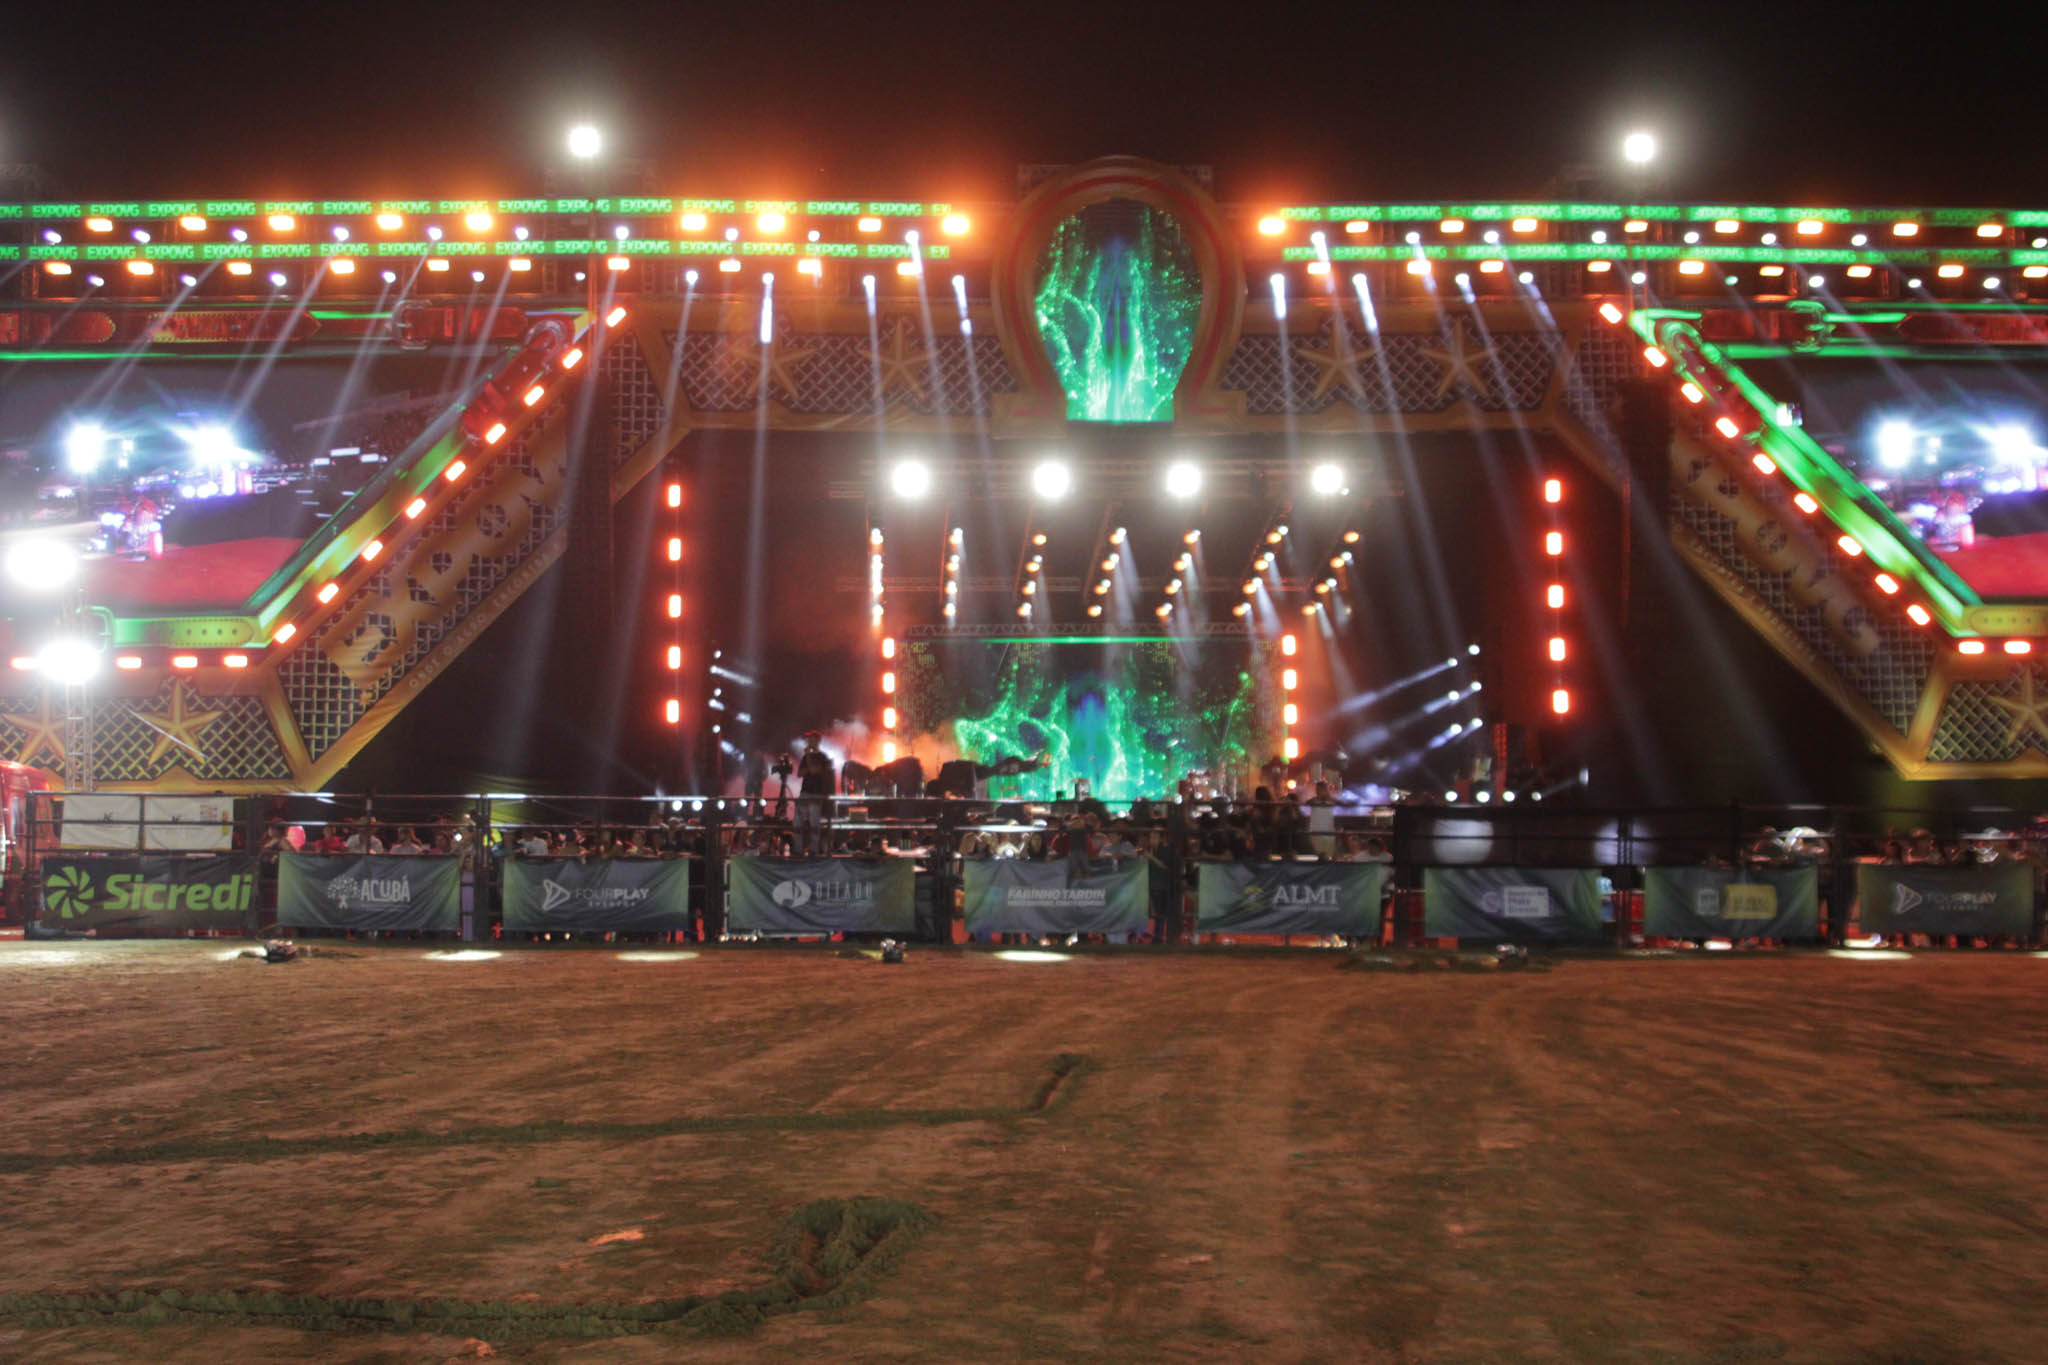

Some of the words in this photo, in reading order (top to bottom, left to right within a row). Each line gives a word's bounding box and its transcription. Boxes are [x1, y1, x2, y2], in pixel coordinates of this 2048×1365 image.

[32, 205, 81, 218] EXPOVG
[90, 203, 139, 216] EXPOVG
[149, 203, 198, 216] EXPOVG
[207, 202, 256, 216] EXPOVG
[265, 201, 314, 214] EXPOVG
[322, 201, 371, 214] EXPOVG
[381, 200, 431, 213] EXPOVG
[440, 200, 489, 213] EXPOVG
[498, 200, 547, 213] EXPOVG
[620, 199, 672, 213] EXPOVG
[683, 200, 735, 213] EXPOVG
[808, 202, 860, 215] EXPOVG
[869, 203, 922, 216] EXPOVG
[29, 246, 78, 259] EXPOVG
[87, 246, 136, 259] EXPOVG
[145, 245, 194, 258] EXPOVG
[203, 245, 252, 258] EXPOVG
[261, 244, 311, 257] EXPOVG
[320, 243, 369, 256] EXPOVG
[378, 243, 427, 256] EXPOVG
[437, 242, 486, 255] EXPOVG
[495, 241, 545, 254] EXPOVG
[618, 240, 670, 253] EXPOVG
[680, 241, 732, 254] EXPOVG
[743, 242, 795, 255] EXPOVG
[805, 243, 858, 257] EXPOVG
[103, 874, 253, 911] Sicredi
[360, 874, 411, 903] ACUBÁ
[575, 888, 650, 900] FOURPLAY
[1272, 885, 1342, 905] ALMT
